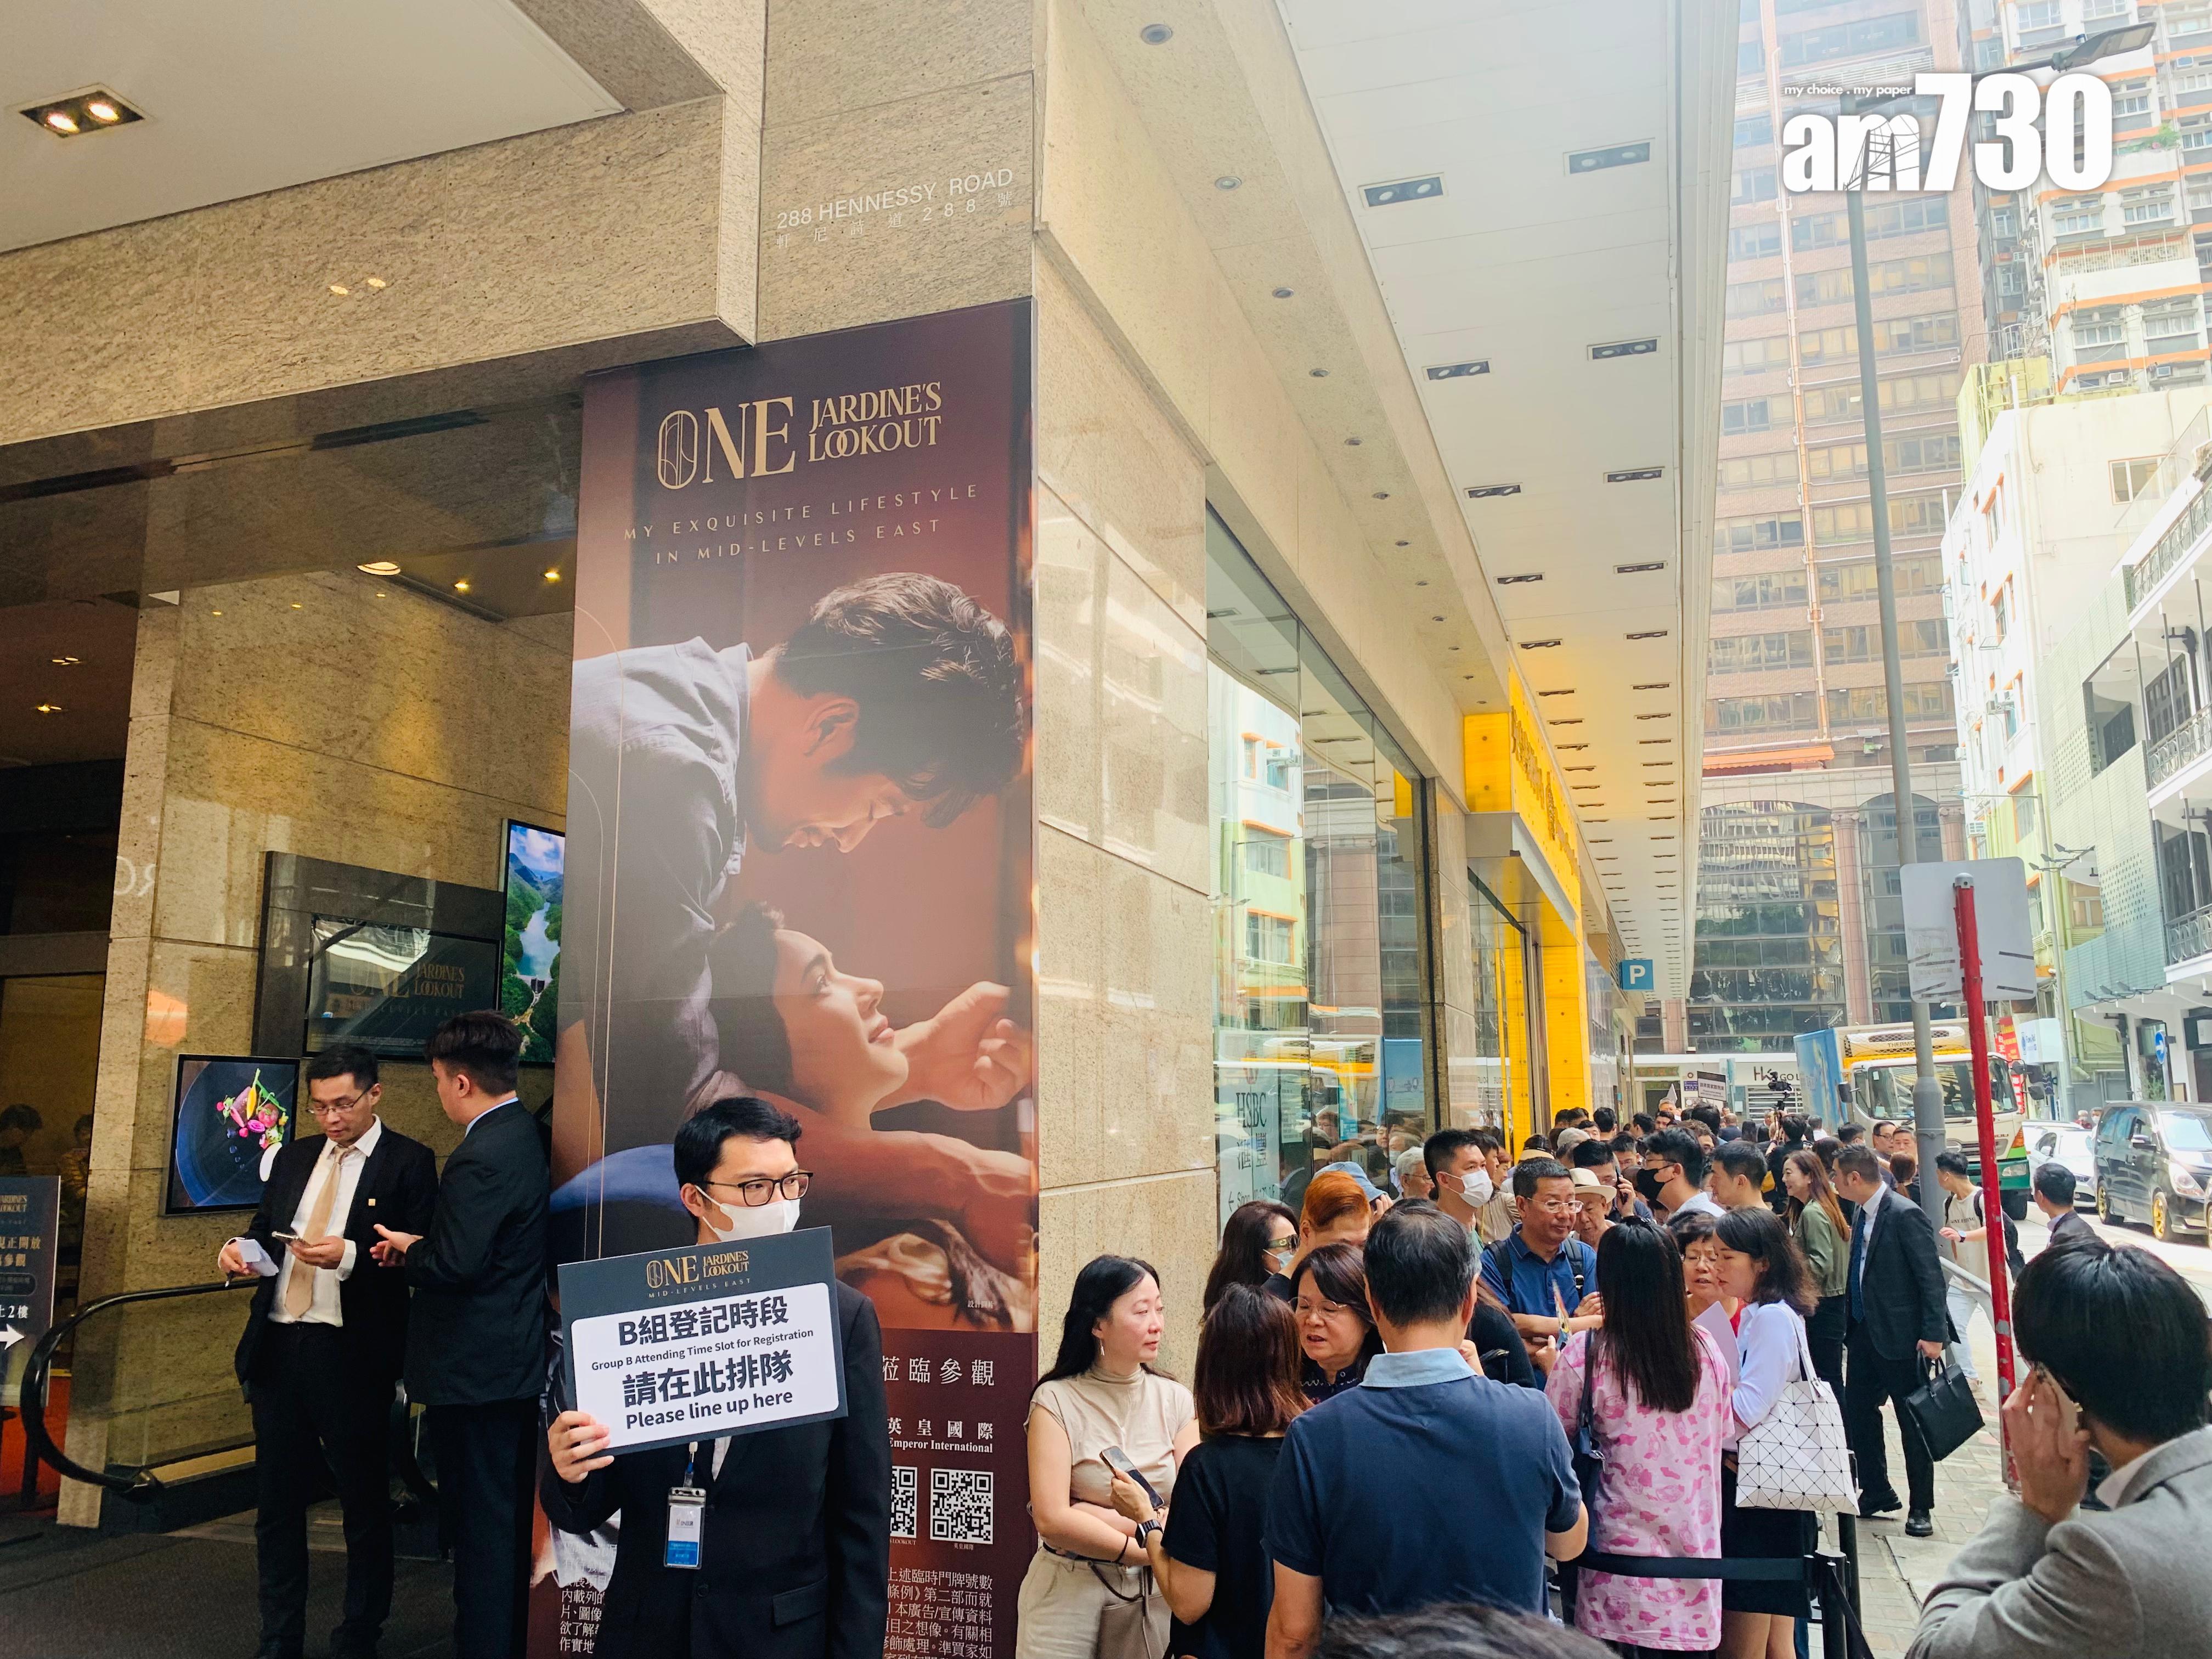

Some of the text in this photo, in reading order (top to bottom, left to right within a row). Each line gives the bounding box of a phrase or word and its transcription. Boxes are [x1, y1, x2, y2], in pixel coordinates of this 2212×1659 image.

[777, 168, 1013, 229] 288 HENNESSY ROAD
[657, 381, 942, 490] ONE JARDINE'S
[808, 416, 943, 462] LOOKOUT
[624, 484, 978, 541] MY EXQUISITE LIFESTYLE
[656, 519, 940, 565] IN MID-LEVELS EAST
[1629, 965, 1646, 984] P
[1236, 1092, 1267, 1128] HSBC
[646, 1250, 749, 1288] ONE JARDINE'S
[648, 1278, 751, 1299] MID-LEVELS EAST
[703, 1261, 749, 1278] LOOKOUT
[618, 1295, 789, 1346] B組登記時段
[591, 1328, 814, 1371] Group B Attending Time Slot for Registration
[622, 1349, 794, 1408] 請在此排隊
[627, 1389, 793, 1430] Please line up here
[887, 1417, 993, 1440] 英皇國際
[930, 1439, 993, 1453] International
[560, 1621, 599, 1638] 欲了解
